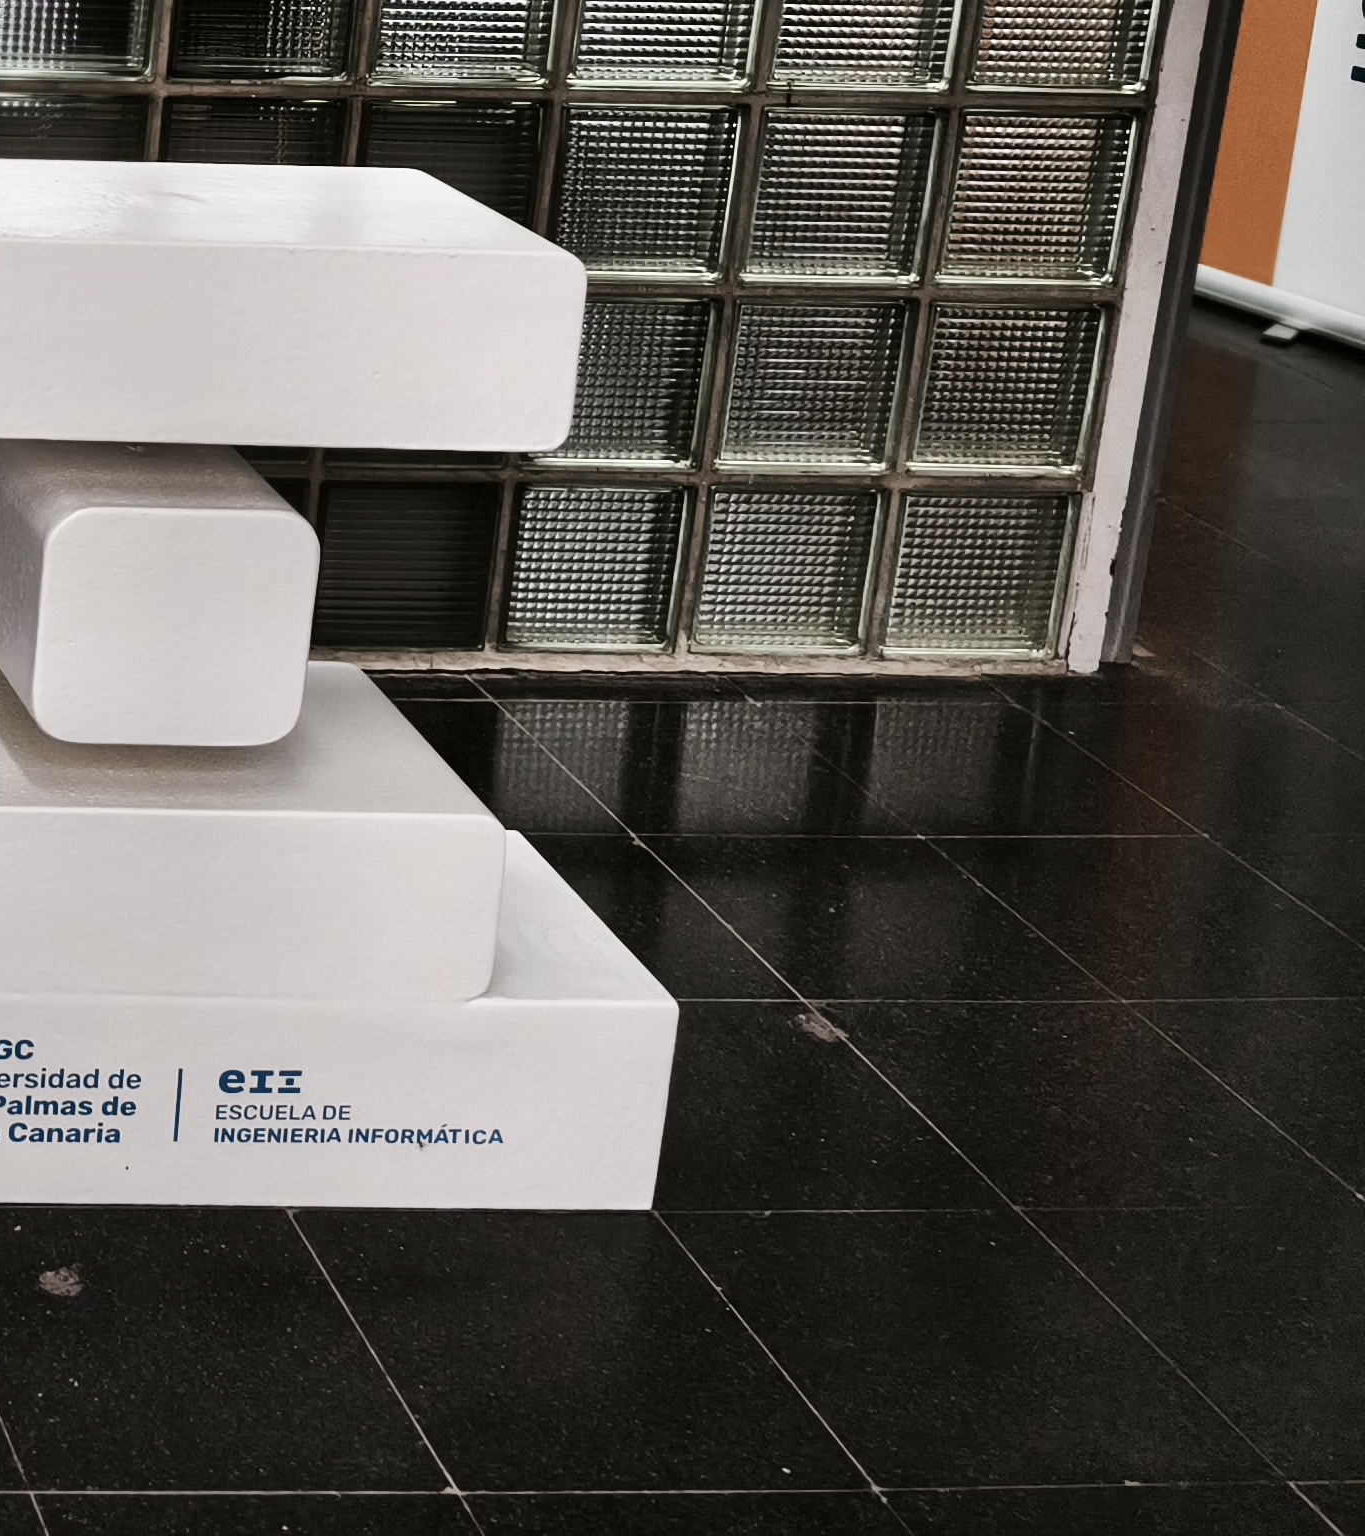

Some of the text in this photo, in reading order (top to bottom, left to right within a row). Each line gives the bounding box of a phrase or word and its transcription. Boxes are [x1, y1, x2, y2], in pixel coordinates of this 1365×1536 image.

[108, 1069, 142, 1090] de
[101, 1096, 137, 1116] de
[215, 1105, 351, 1120] ESCUELA DE
[8, 1122, 121, 1143] Canaria
[213, 1124, 504, 1145] INGENIERIA INFORMÁTICA
